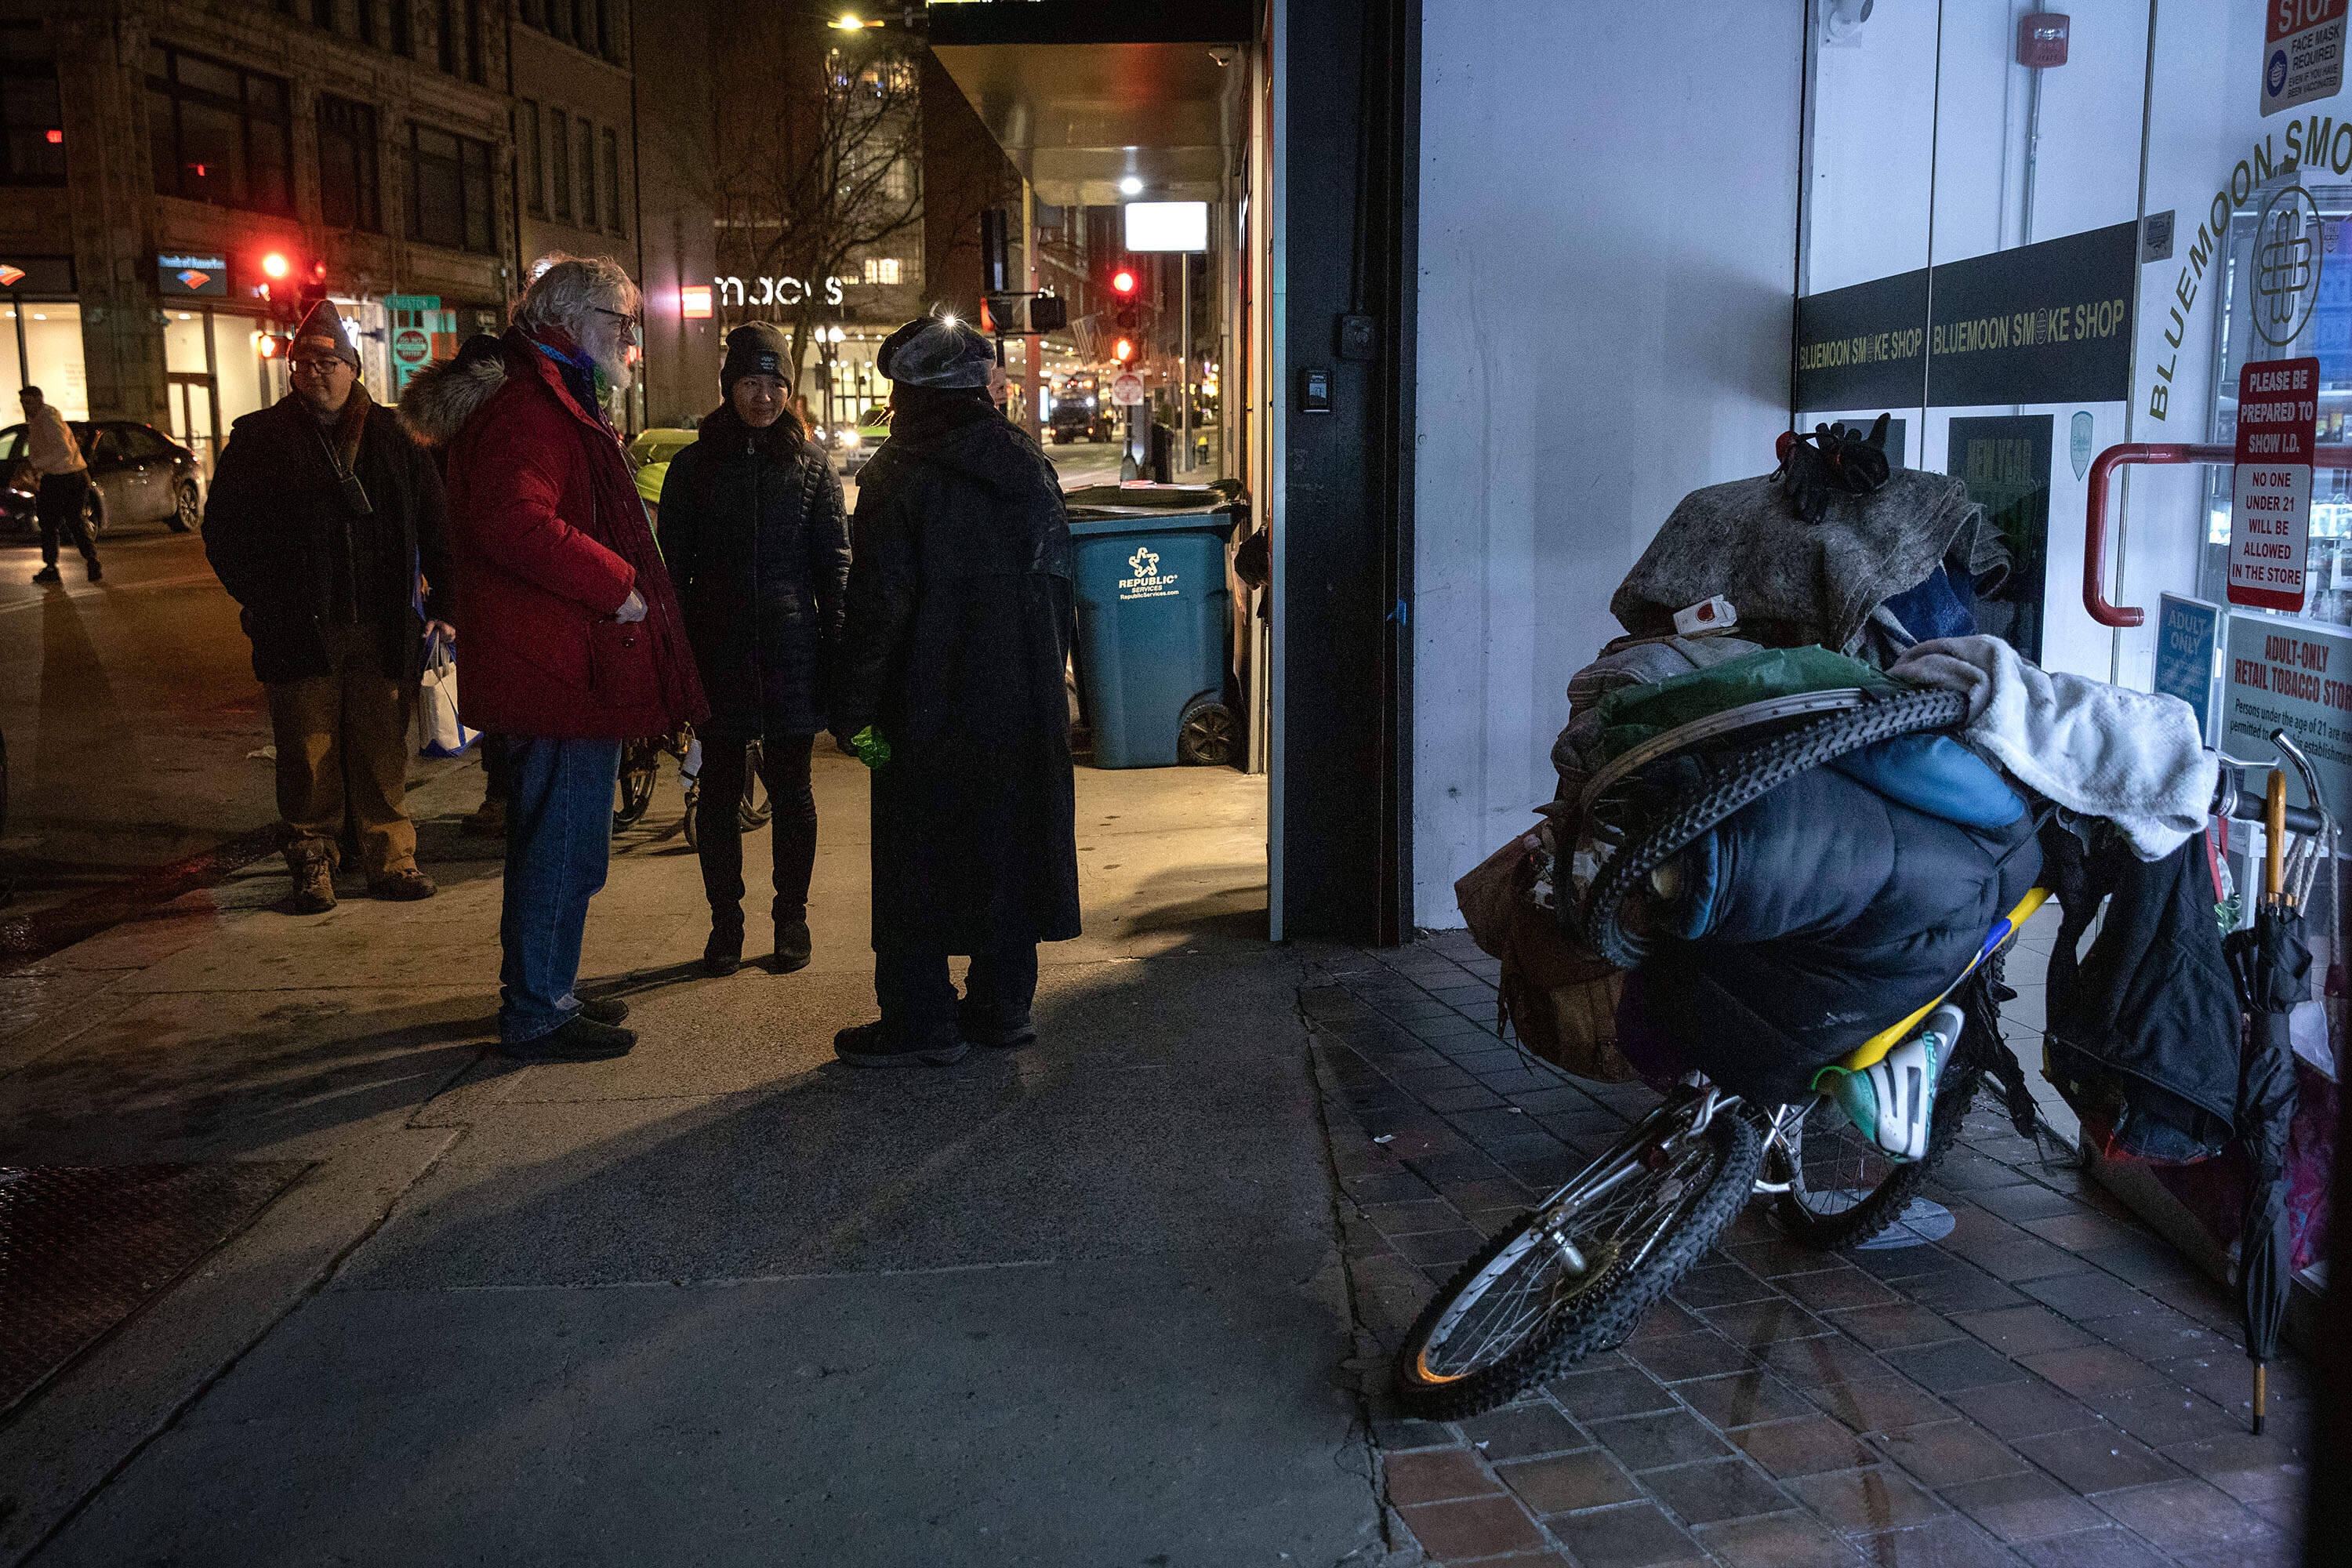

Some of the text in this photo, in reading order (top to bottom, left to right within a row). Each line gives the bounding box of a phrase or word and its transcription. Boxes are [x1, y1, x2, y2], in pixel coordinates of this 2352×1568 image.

[2292, 23, 2341, 54] FACE MASK
[2292, 44, 2336, 71] REQUIRED
[2288, 74, 2303, 87] EVEN
[2310, 68, 2321, 79] YOU
[2304, 76, 2337, 93] VACCINATED
[2149, 134, 2272, 421] BLUEMOON
[1933, 316, 2009, 354] BLUEMOON
[2074, 299, 2125, 340] SHOP
[1799, 339, 1850, 370] BLUEMOON
[1891, 327, 1922, 360] SHOP
[2249, 370, 2308, 393] PLEASE BE
[2240, 401, 2314, 423] PREPARED TO
[2248, 434, 2299, 454] SHOW I.D.
[2252, 472, 2292, 488] NO ONE
[2245, 495, 2295, 512] UNDER 21
[2249, 518, 2289, 535] WILL BE
[2243, 541, 2292, 560] ALLOWED
[2232, 563, 2302, 586] IN THE STORE
[1120, 590, 1179, 600] RepublicServices.com
[1131, 585, 1163, 593] SERVICES
[2167, 610, 2207, 635] ADULT
[2170, 631, 2202, 655] ONLY
[2265, 634, 2329, 673] ADULT-ONLY
[2234, 658, 2268, 691] RETAIL
[2271, 666, 2320, 703] TOBACCO
[2230, 719, 2262, 739] permitted
[2263, 728, 2269, 741] to
[2235, 698, 2260, 719] Persons
[2261, 706, 2281, 724] under
[2282, 711, 2294, 728] the
[2295, 718, 2308, 735] age
[2308, 717, 2318, 734] of
[2318, 720, 2327, 737] 21
[2328, 727, 2340, 741] are
